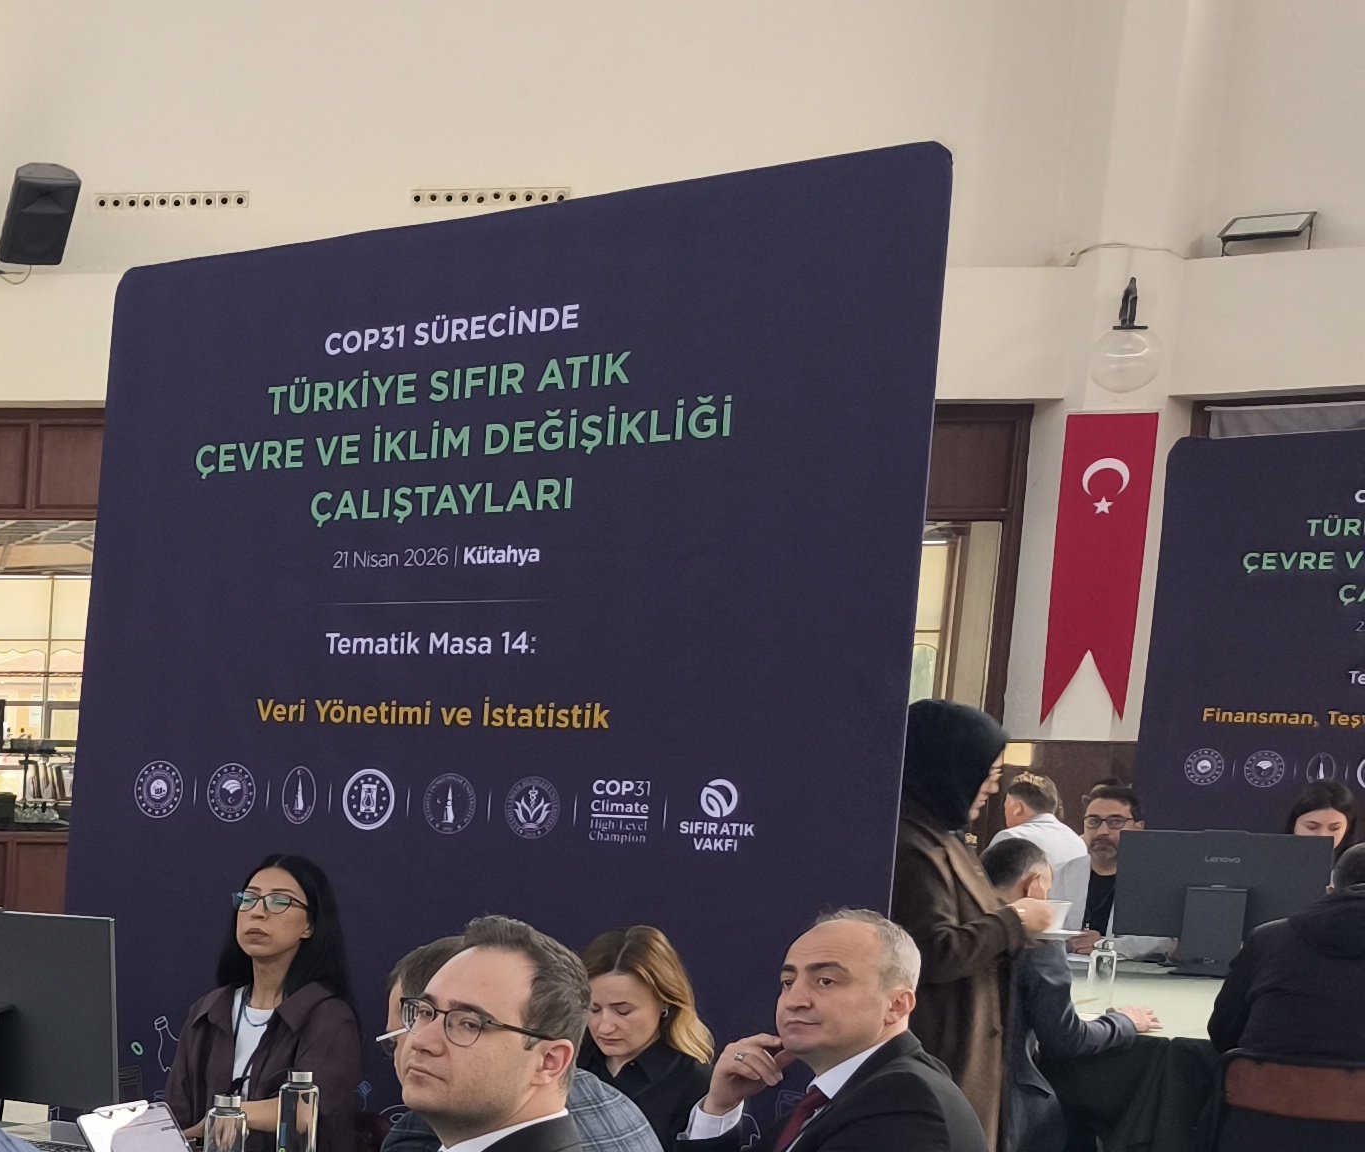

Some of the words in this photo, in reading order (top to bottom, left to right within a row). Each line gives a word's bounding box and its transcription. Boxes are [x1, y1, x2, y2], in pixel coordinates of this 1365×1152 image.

[325, 325, 405, 355] COP31
[414, 304, 579, 345] SÜRECİNDE
[268, 370, 417, 415] TÜRKİYE
[429, 363, 525, 401] SIFIR
[537, 351, 632, 392] ATIK
[195, 438, 304, 479] ÇEVRE
[315, 434, 361, 466] VE
[373, 421, 470, 463] İKLİM
[484, 395, 732, 455] DEĞİŞİKLİĞİ
[310, 478, 573, 527] ÇALIŞTAYLARI
[1307, 514, 1365, 537] TÜR
[332, 551, 349, 568] 21
[353, 550, 399, 568] Nisan
[403, 548, 449, 567] 2026
[463, 545, 540, 566] Kütahya
[1242, 551, 1335, 574] ÇEVRE
[325, 632, 420, 654] Tematik
[428, 632, 492, 655] Masa
[501, 631, 536, 654] 14:
[257, 698, 306, 722] Veri
[315, 700, 431, 725] Yönetimi
[441, 706, 472, 725] ve
[482, 697, 611, 728] İstatistik
[1202, 707, 1319, 728] Finansman,
[592, 780, 651, 797] COP31
[590, 800, 649, 814] Climate
[679, 821, 717, 835] SIFIR
[719, 822, 755, 836] ATIK
[693, 838, 738, 851] VAKFI
